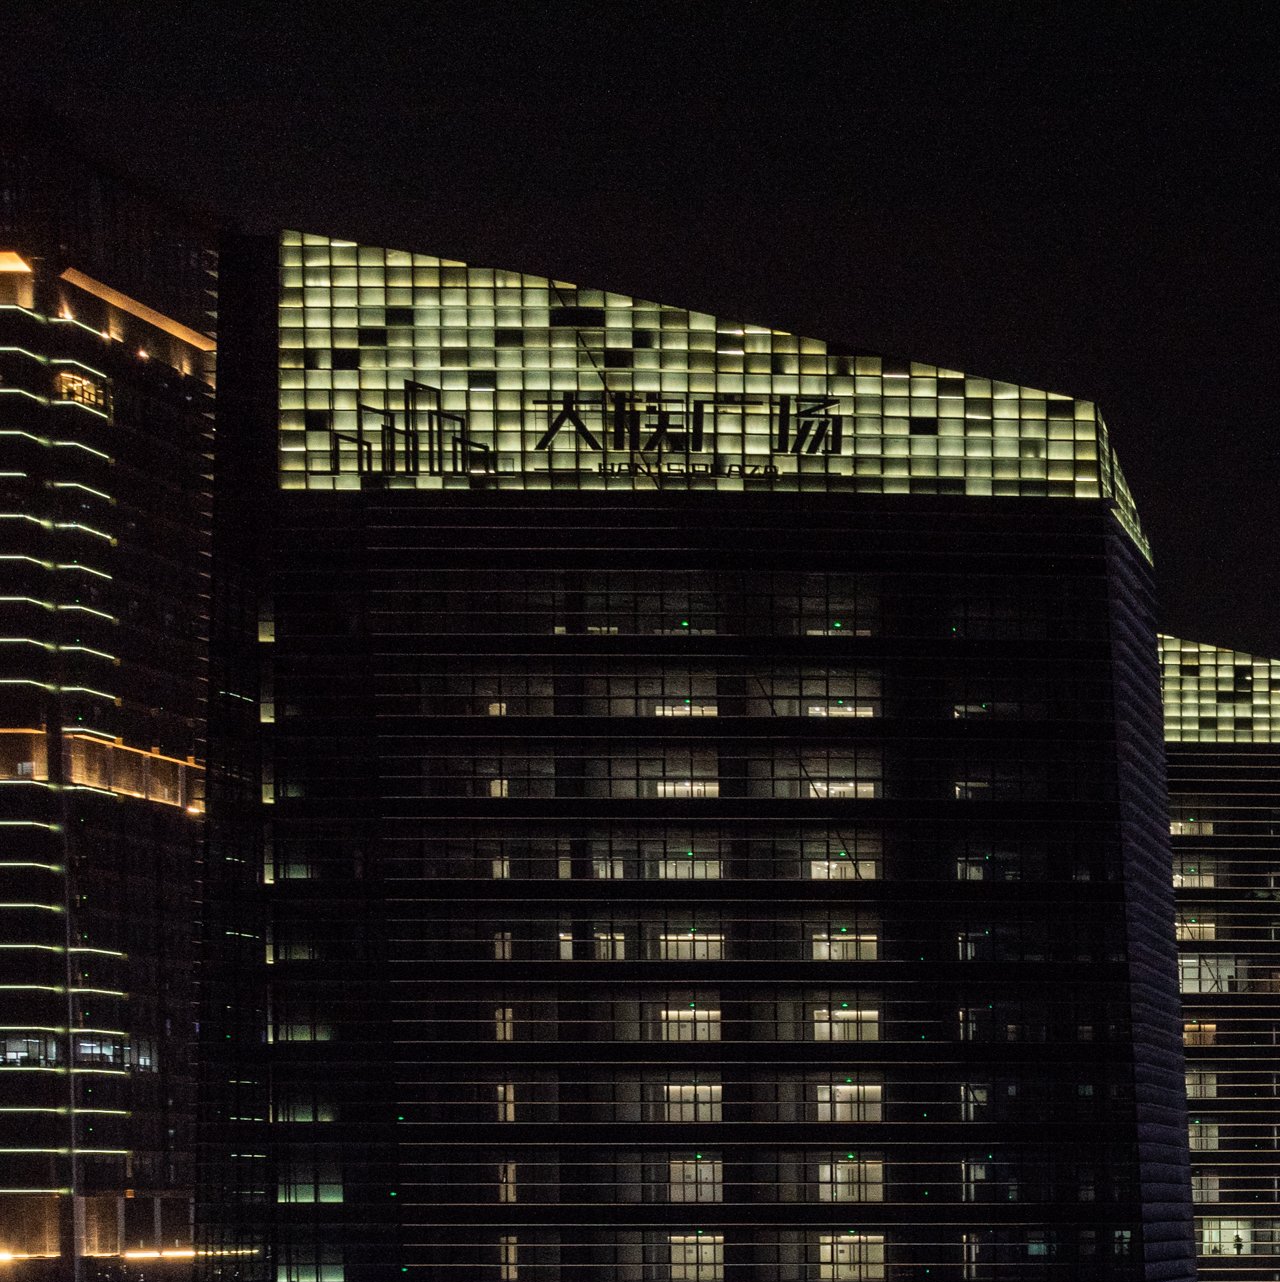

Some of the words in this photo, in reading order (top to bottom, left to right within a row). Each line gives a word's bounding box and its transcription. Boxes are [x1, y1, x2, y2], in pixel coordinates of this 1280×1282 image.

[533, 391, 842, 454] 大族广场
[691, 463, 778, 479] PLAZA
